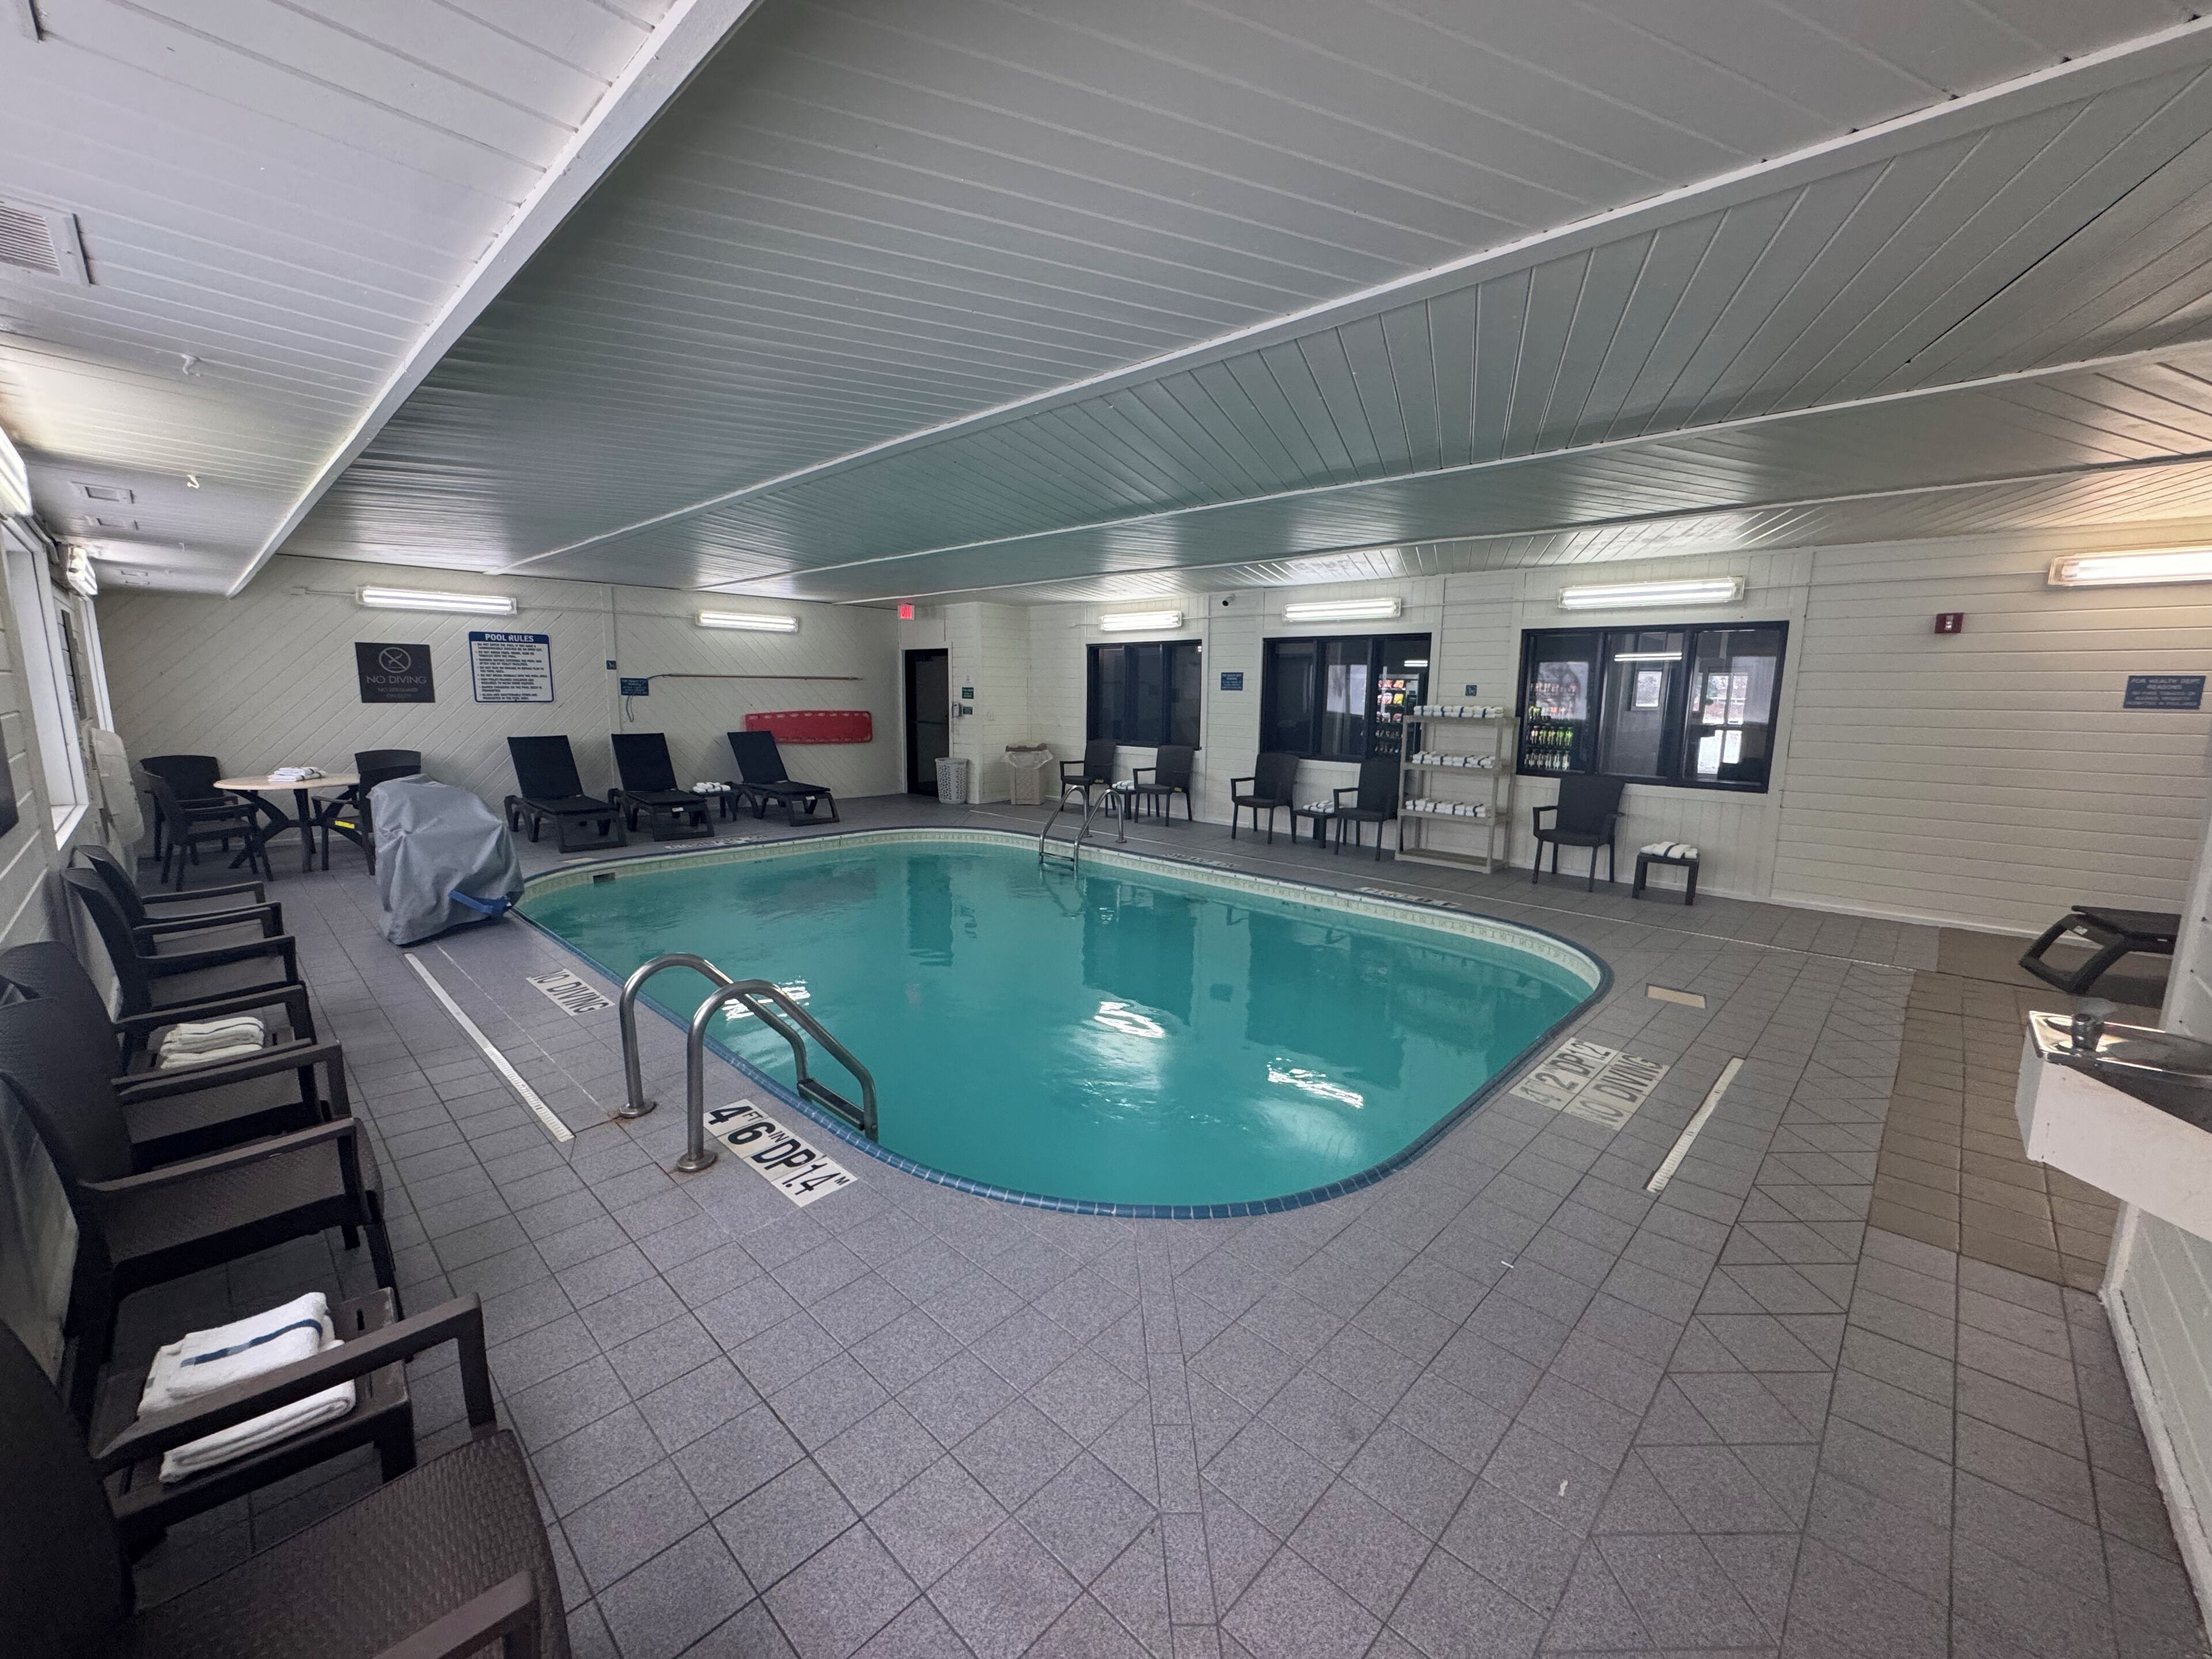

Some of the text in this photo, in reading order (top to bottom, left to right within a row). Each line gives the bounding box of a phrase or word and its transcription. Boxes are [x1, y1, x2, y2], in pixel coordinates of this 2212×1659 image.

[508, 634, 535, 642] RULES
[366, 675, 427, 684] NO DIVING
[546, 981, 609, 1013] DIVING
[1535, 1072, 1580, 1090] 2
[1592, 1054, 1664, 1103] DIVING
